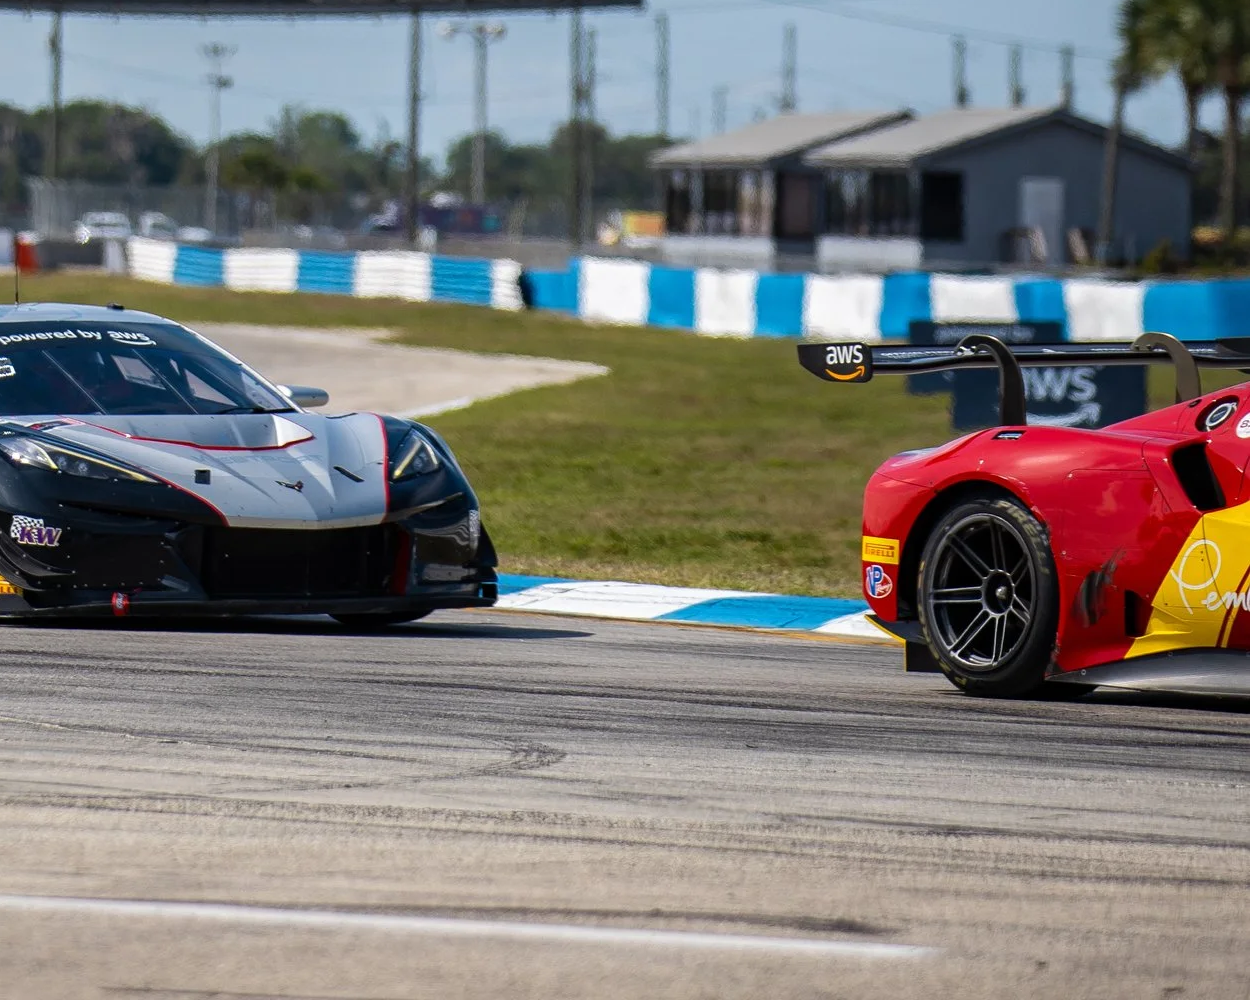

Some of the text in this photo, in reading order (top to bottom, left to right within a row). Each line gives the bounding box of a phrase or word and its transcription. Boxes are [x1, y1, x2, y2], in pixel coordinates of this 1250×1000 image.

[78, 329, 102, 340] by
[107, 331, 156, 345] aws
[826, 345, 863, 365] aws
[18, 527, 62, 547] KW
[865, 543, 895, 558] PIRELLI
[866, 565, 883, 597] VP
